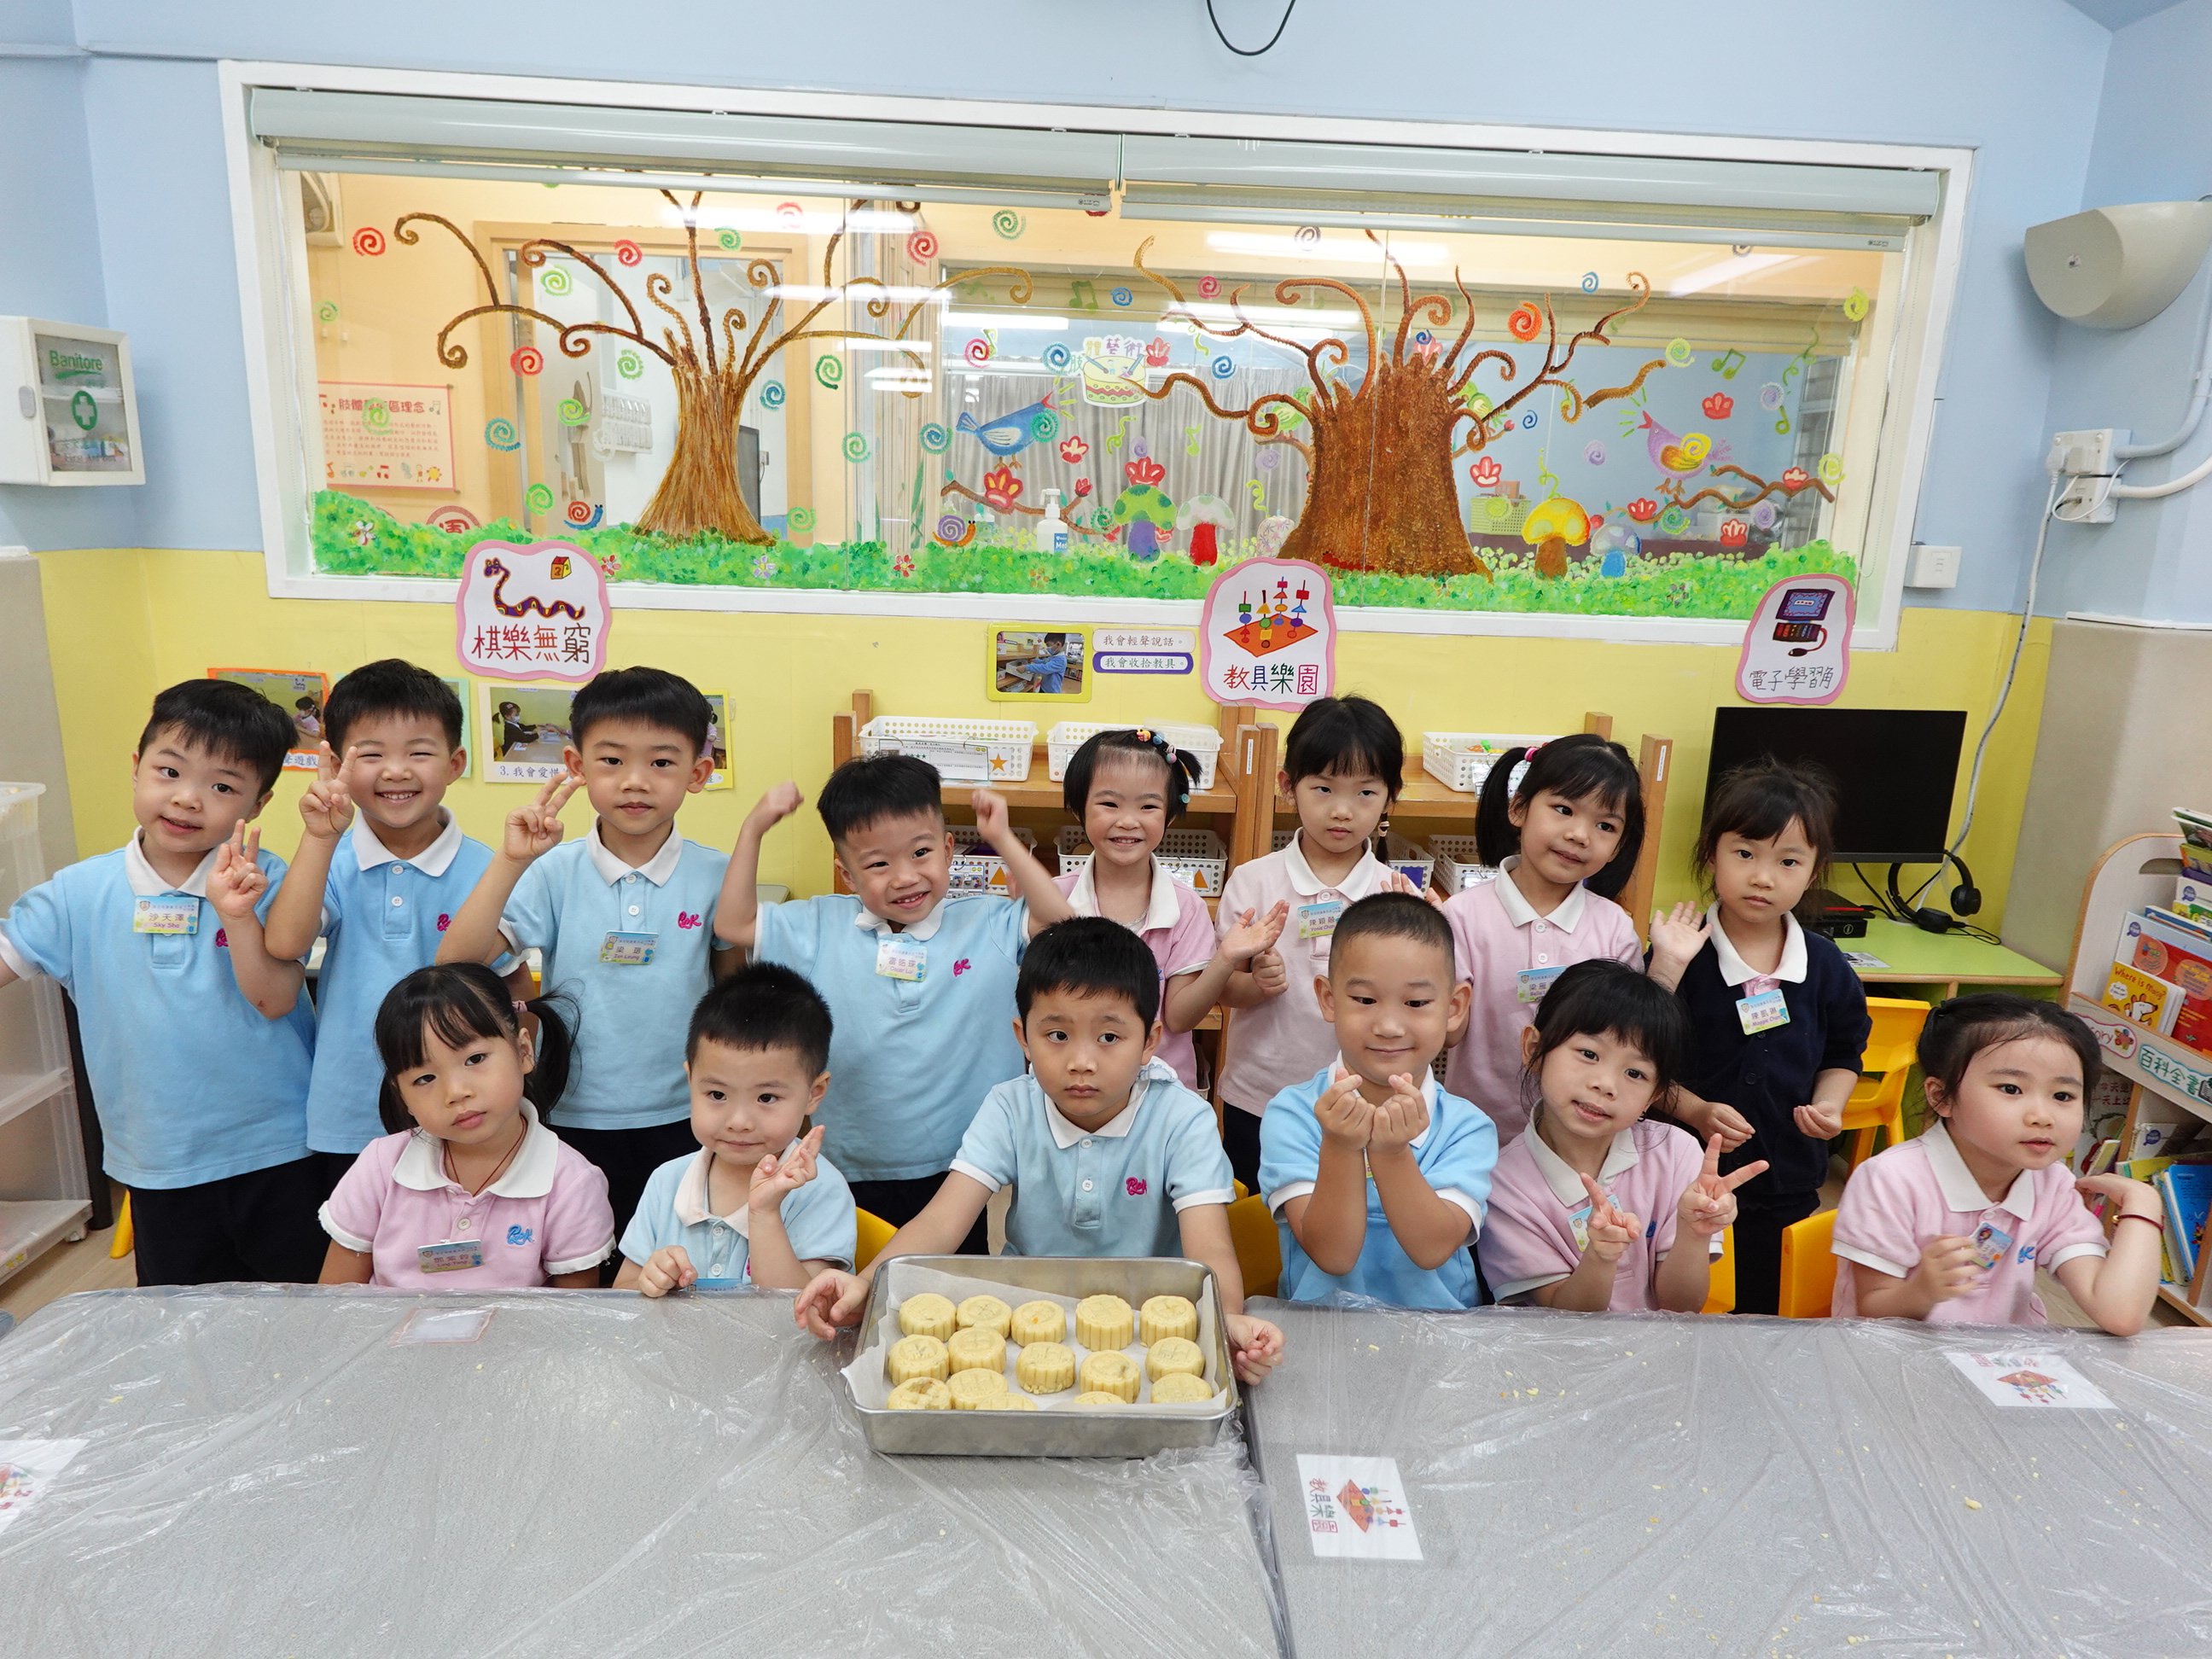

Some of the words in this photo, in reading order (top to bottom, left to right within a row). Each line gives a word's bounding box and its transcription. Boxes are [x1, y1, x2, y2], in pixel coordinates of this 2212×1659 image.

[49, 350, 103, 371] Banitore
[339, 399, 425, 413] 肢體區理念
[472, 623, 591, 664] 棋樂無窮
[1223, 663, 1319, 695] 教具樂園
[1749, 666, 1834, 692] 電子學習角
[2115, 966, 2137, 983] Where
[2138, 978, 2145, 987] is
